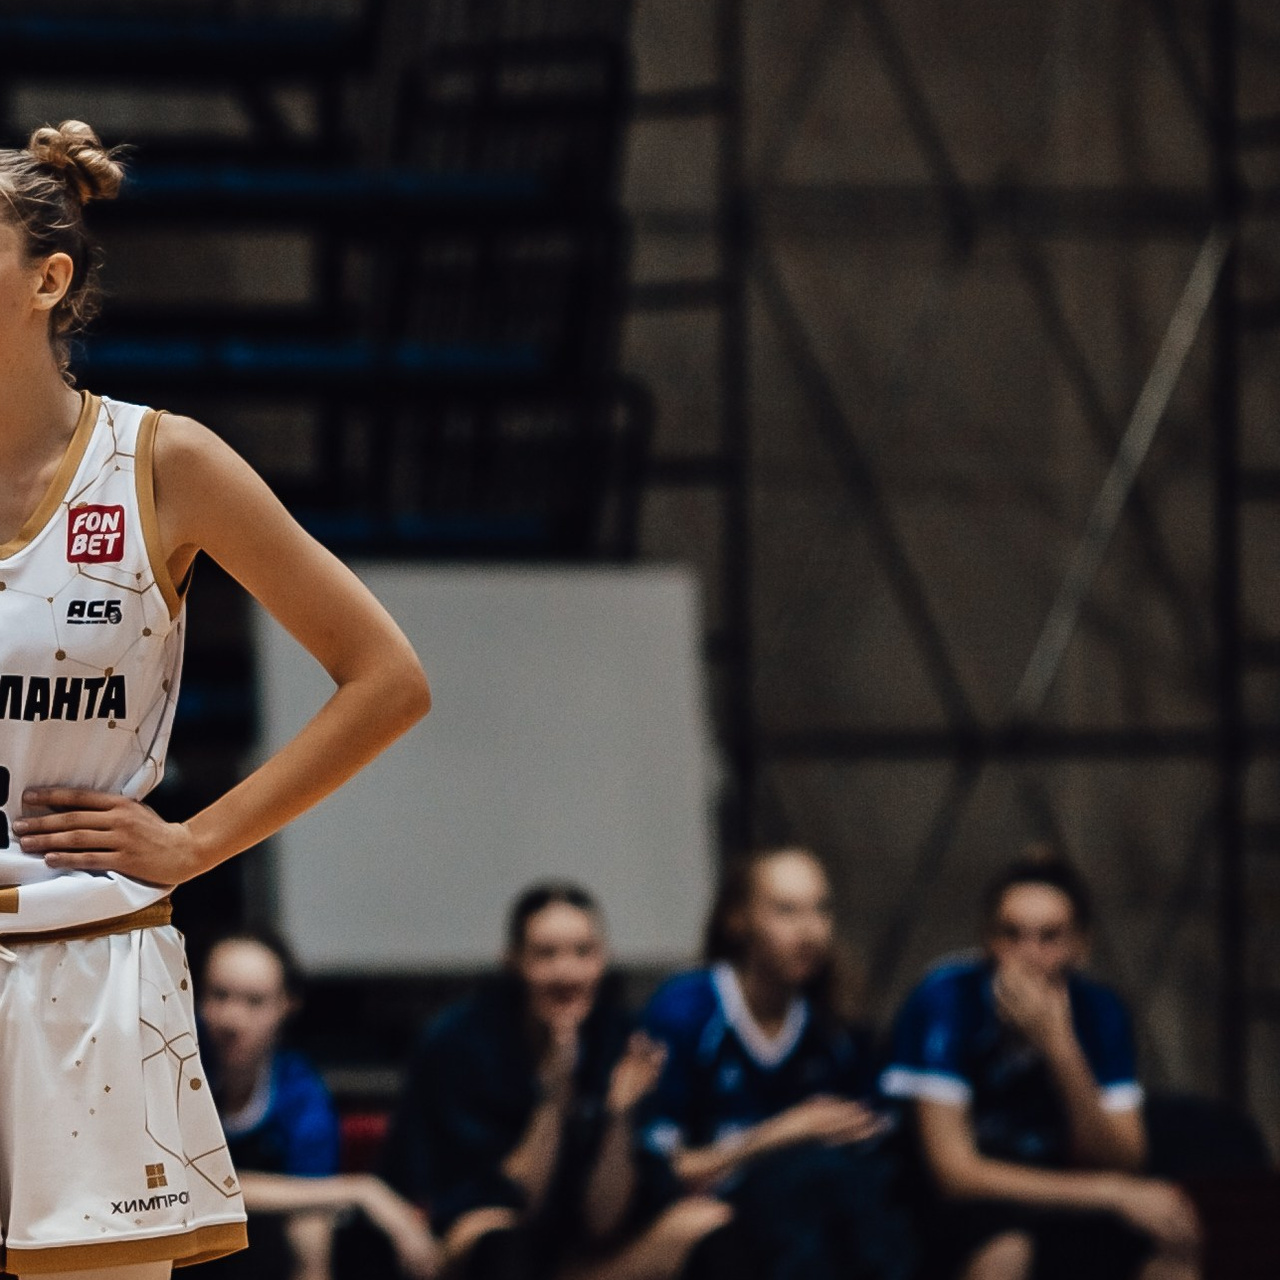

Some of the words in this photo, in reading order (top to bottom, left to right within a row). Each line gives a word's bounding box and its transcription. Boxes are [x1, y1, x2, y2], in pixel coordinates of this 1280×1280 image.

[72, 511, 120, 534] FON
[71, 532, 121, 556] BET
[67, 600, 122, 622] АСБ
[111, 1190, 190, 1215] ХИМПРО
